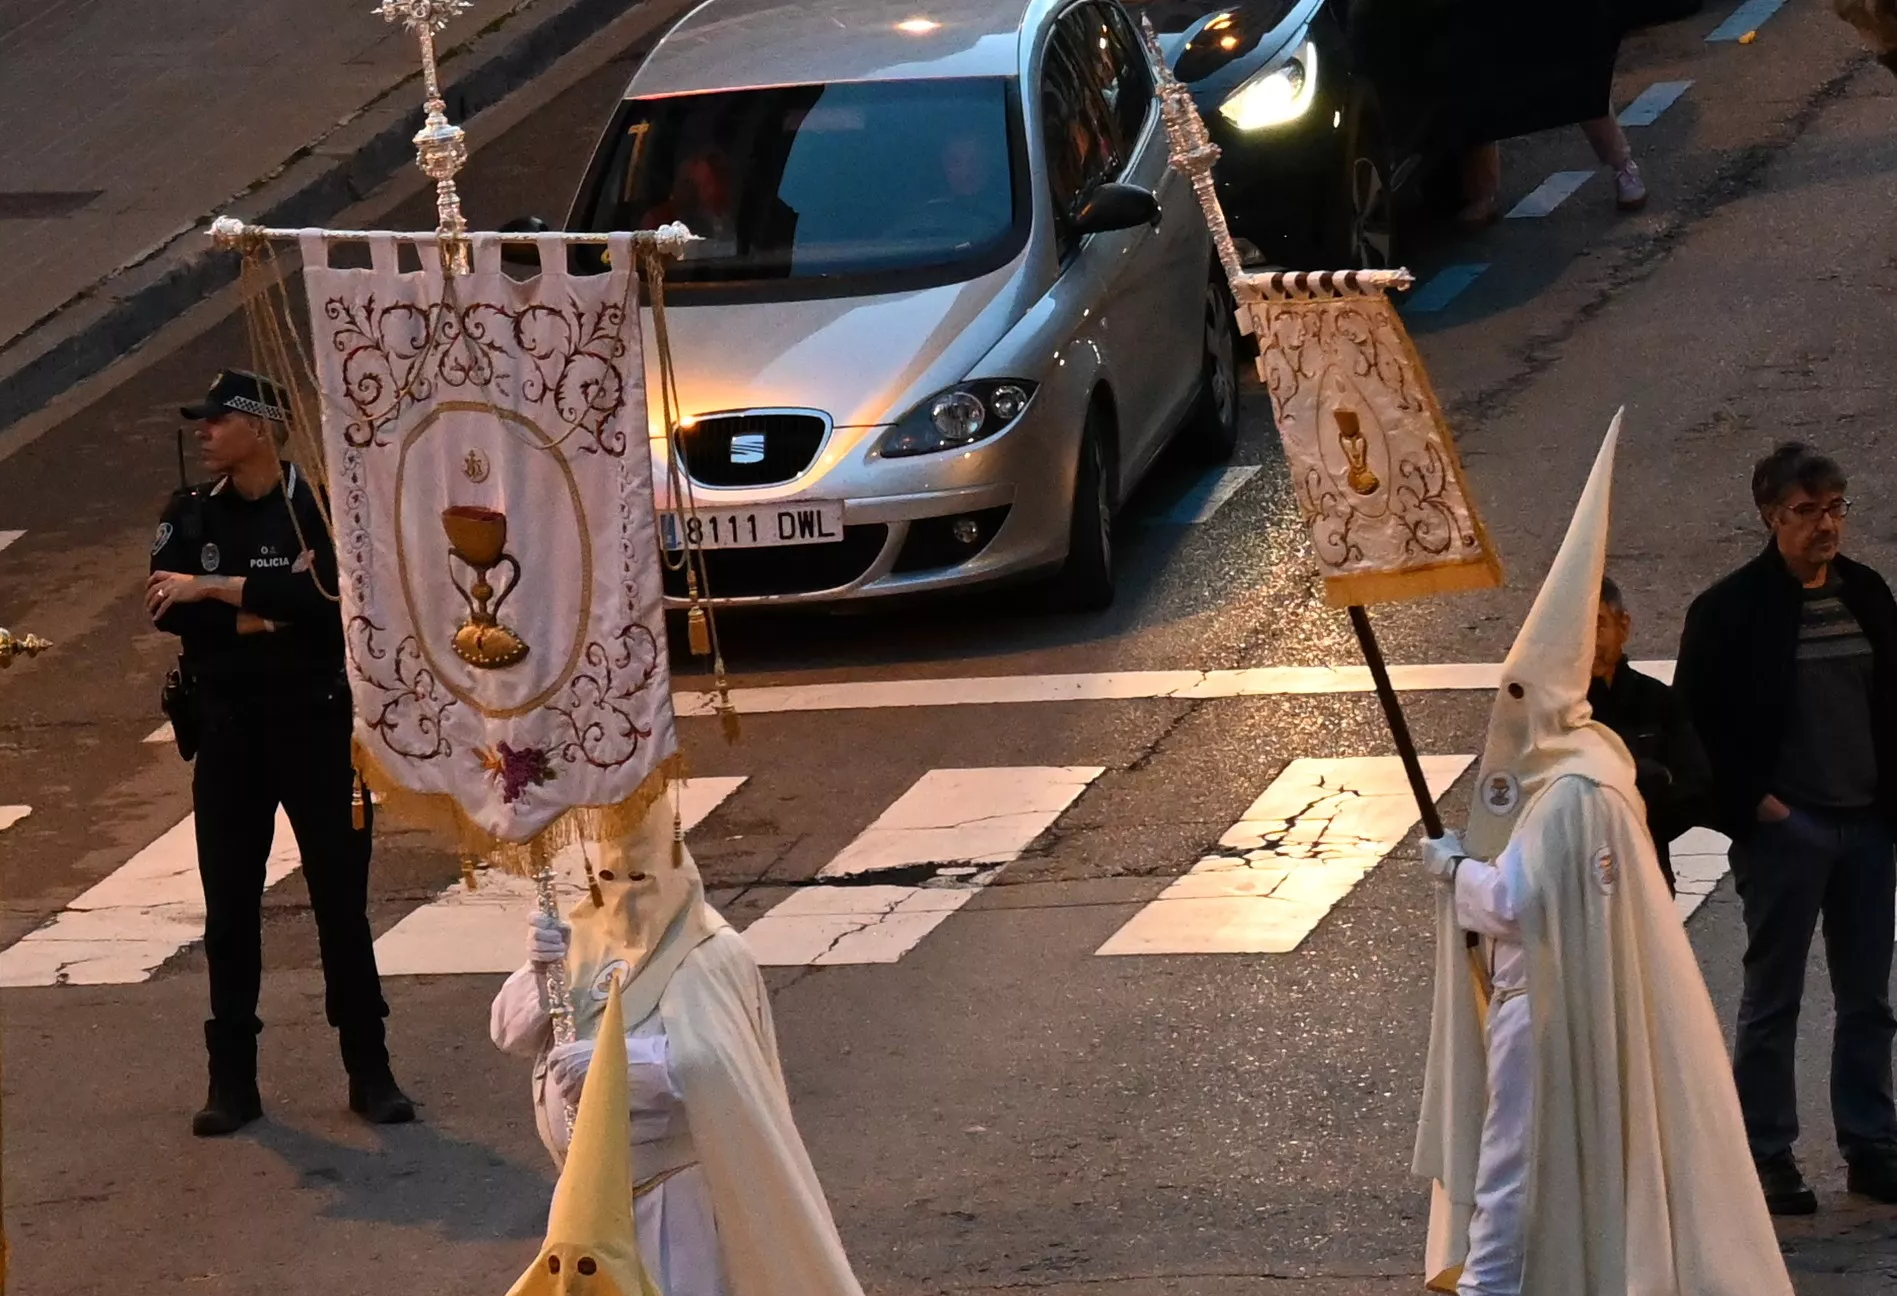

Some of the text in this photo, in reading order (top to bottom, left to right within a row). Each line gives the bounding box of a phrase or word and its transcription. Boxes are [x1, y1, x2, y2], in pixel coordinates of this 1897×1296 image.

[687, 510, 835, 544] 8111 DWL
[250, 557, 290, 568] POLICIA
